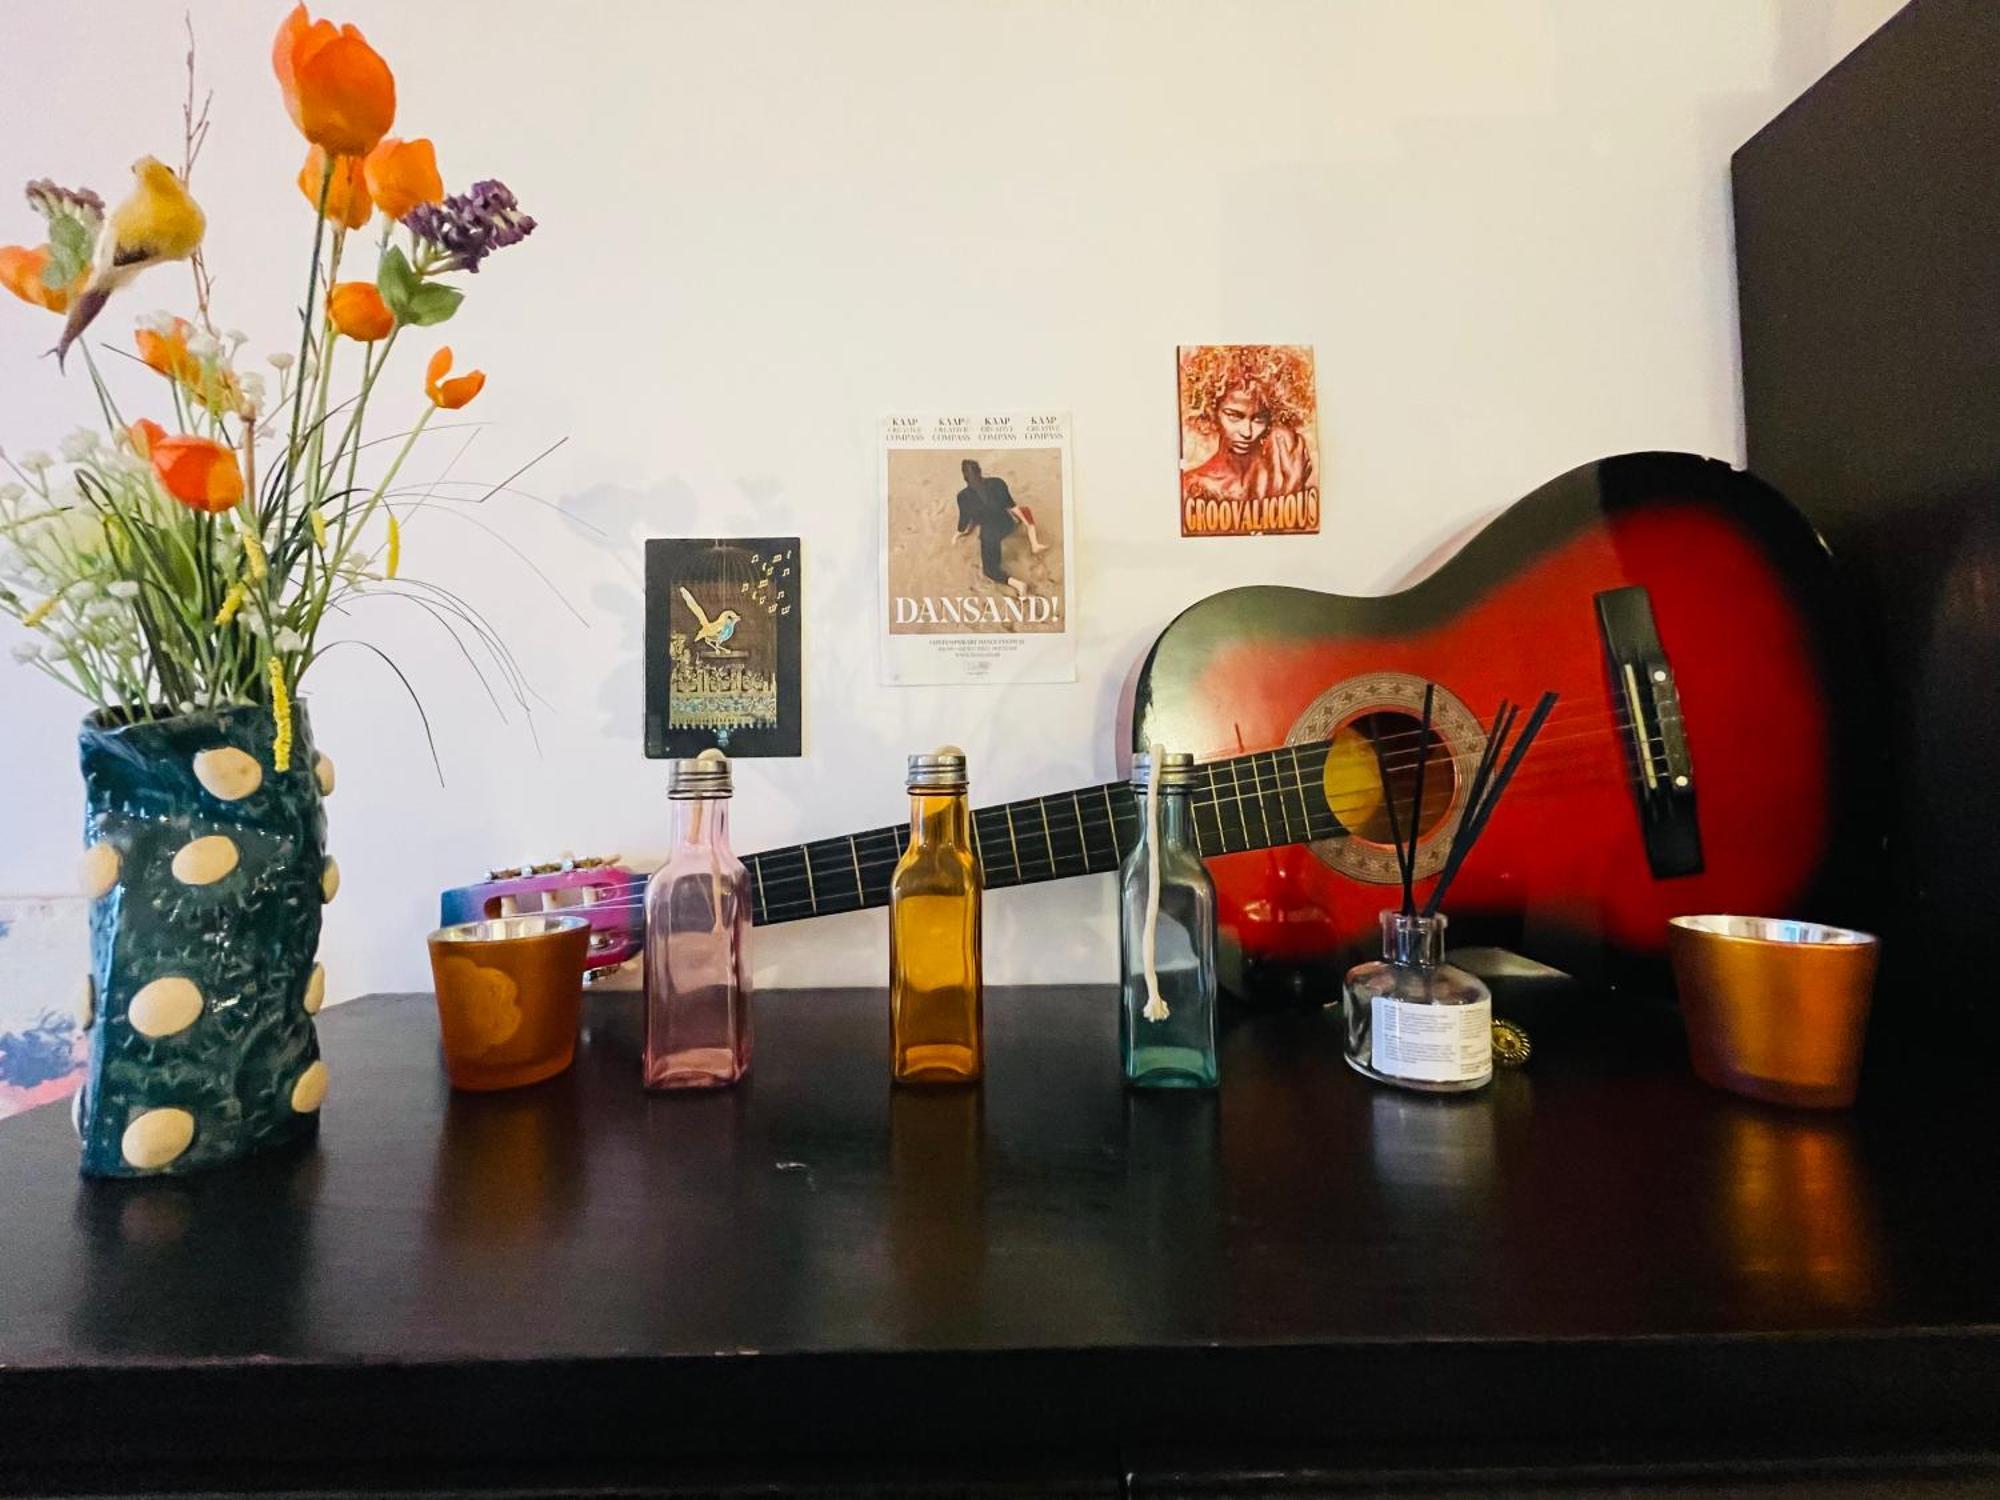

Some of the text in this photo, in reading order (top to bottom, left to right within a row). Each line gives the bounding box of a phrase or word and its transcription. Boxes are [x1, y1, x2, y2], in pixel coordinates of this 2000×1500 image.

[892, 417, 918, 426] KAAP
[938, 417, 965, 426] KAAP
[984, 416, 1010, 425] KAAP
[1031, 416, 1057, 425] KAAP
[886, 433, 925, 441] COMPASS
[931, 433, 971, 441] COMPASS
[978, 433, 1017, 441] COMPASS
[1024, 432, 1064, 440] COMPASS
[1185, 487, 1318, 531] GROOVALICIOUS
[895, 596, 1059, 624] DANSAND!
